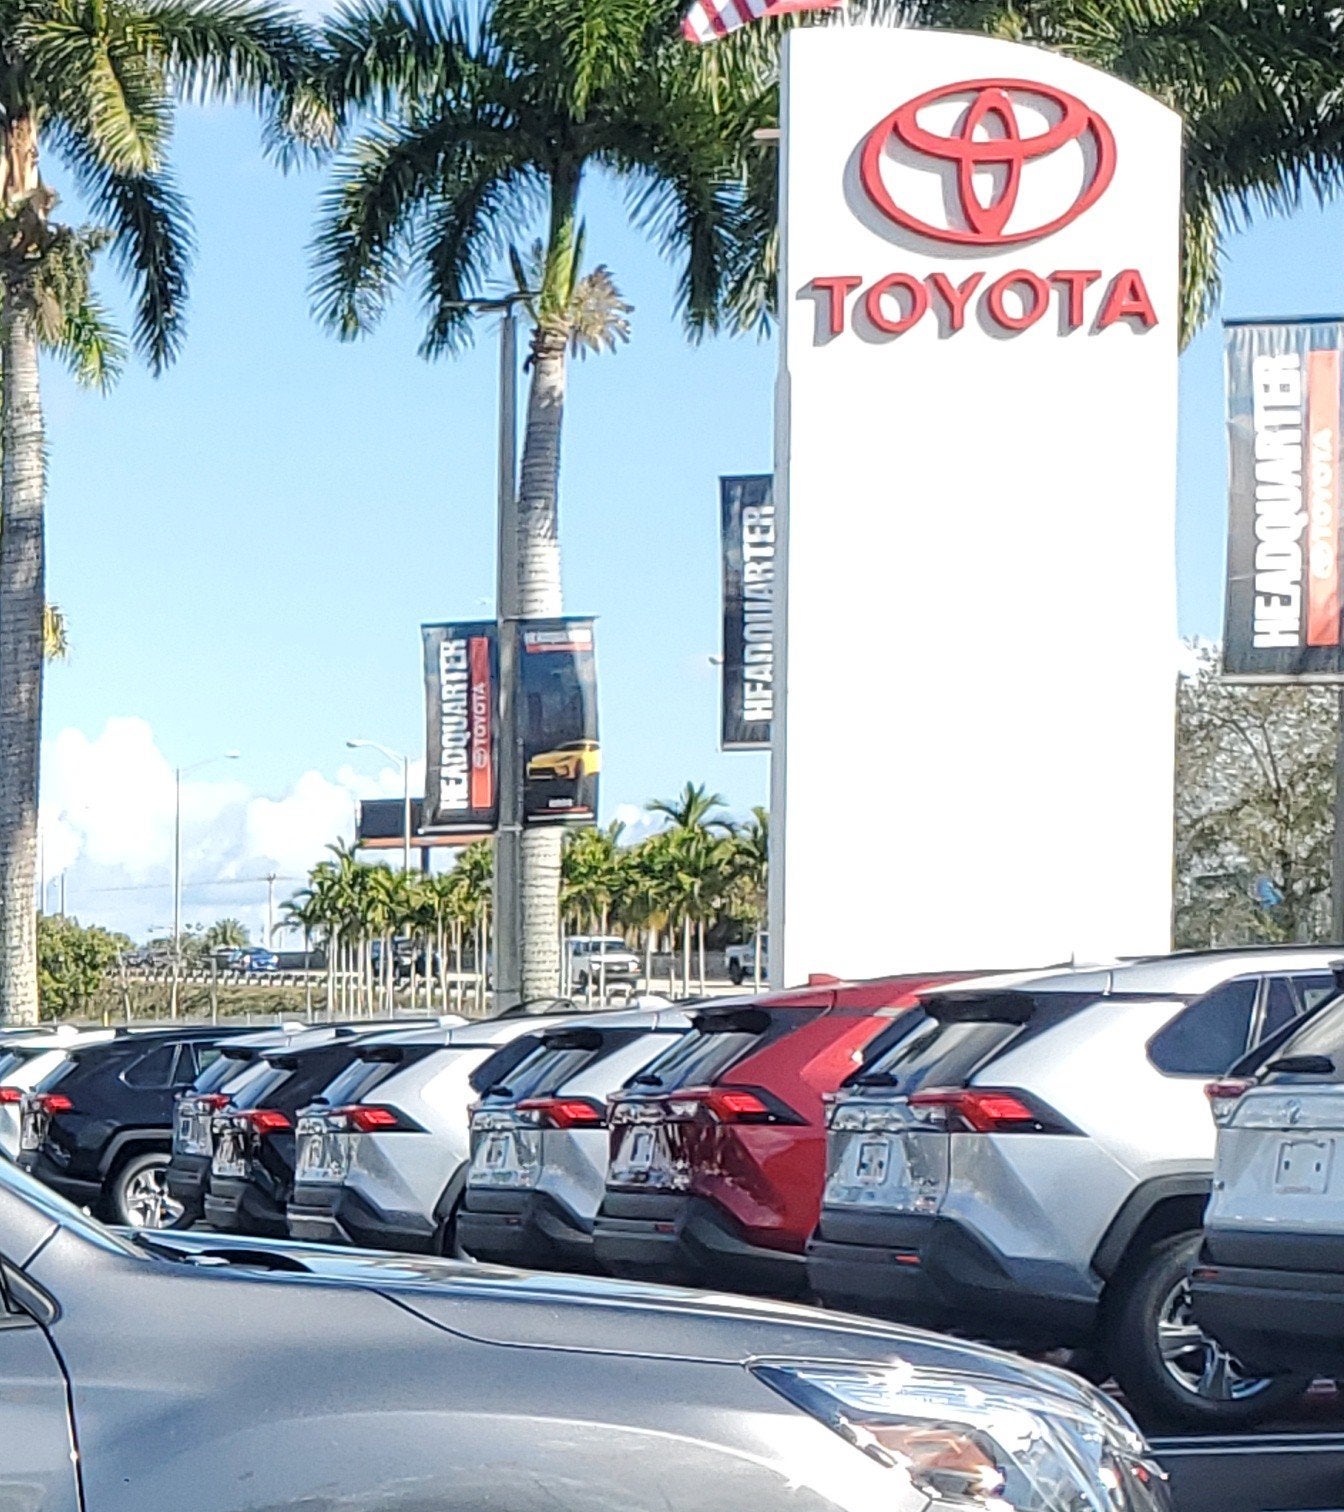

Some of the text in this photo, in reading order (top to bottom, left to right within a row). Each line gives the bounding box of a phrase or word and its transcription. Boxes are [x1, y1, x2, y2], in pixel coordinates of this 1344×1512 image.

[804, 269, 1160, 338] TOYOTA
[1252, 352, 1310, 648] HEADQUARTER
[439, 638, 470, 810] HEADQUARTER
